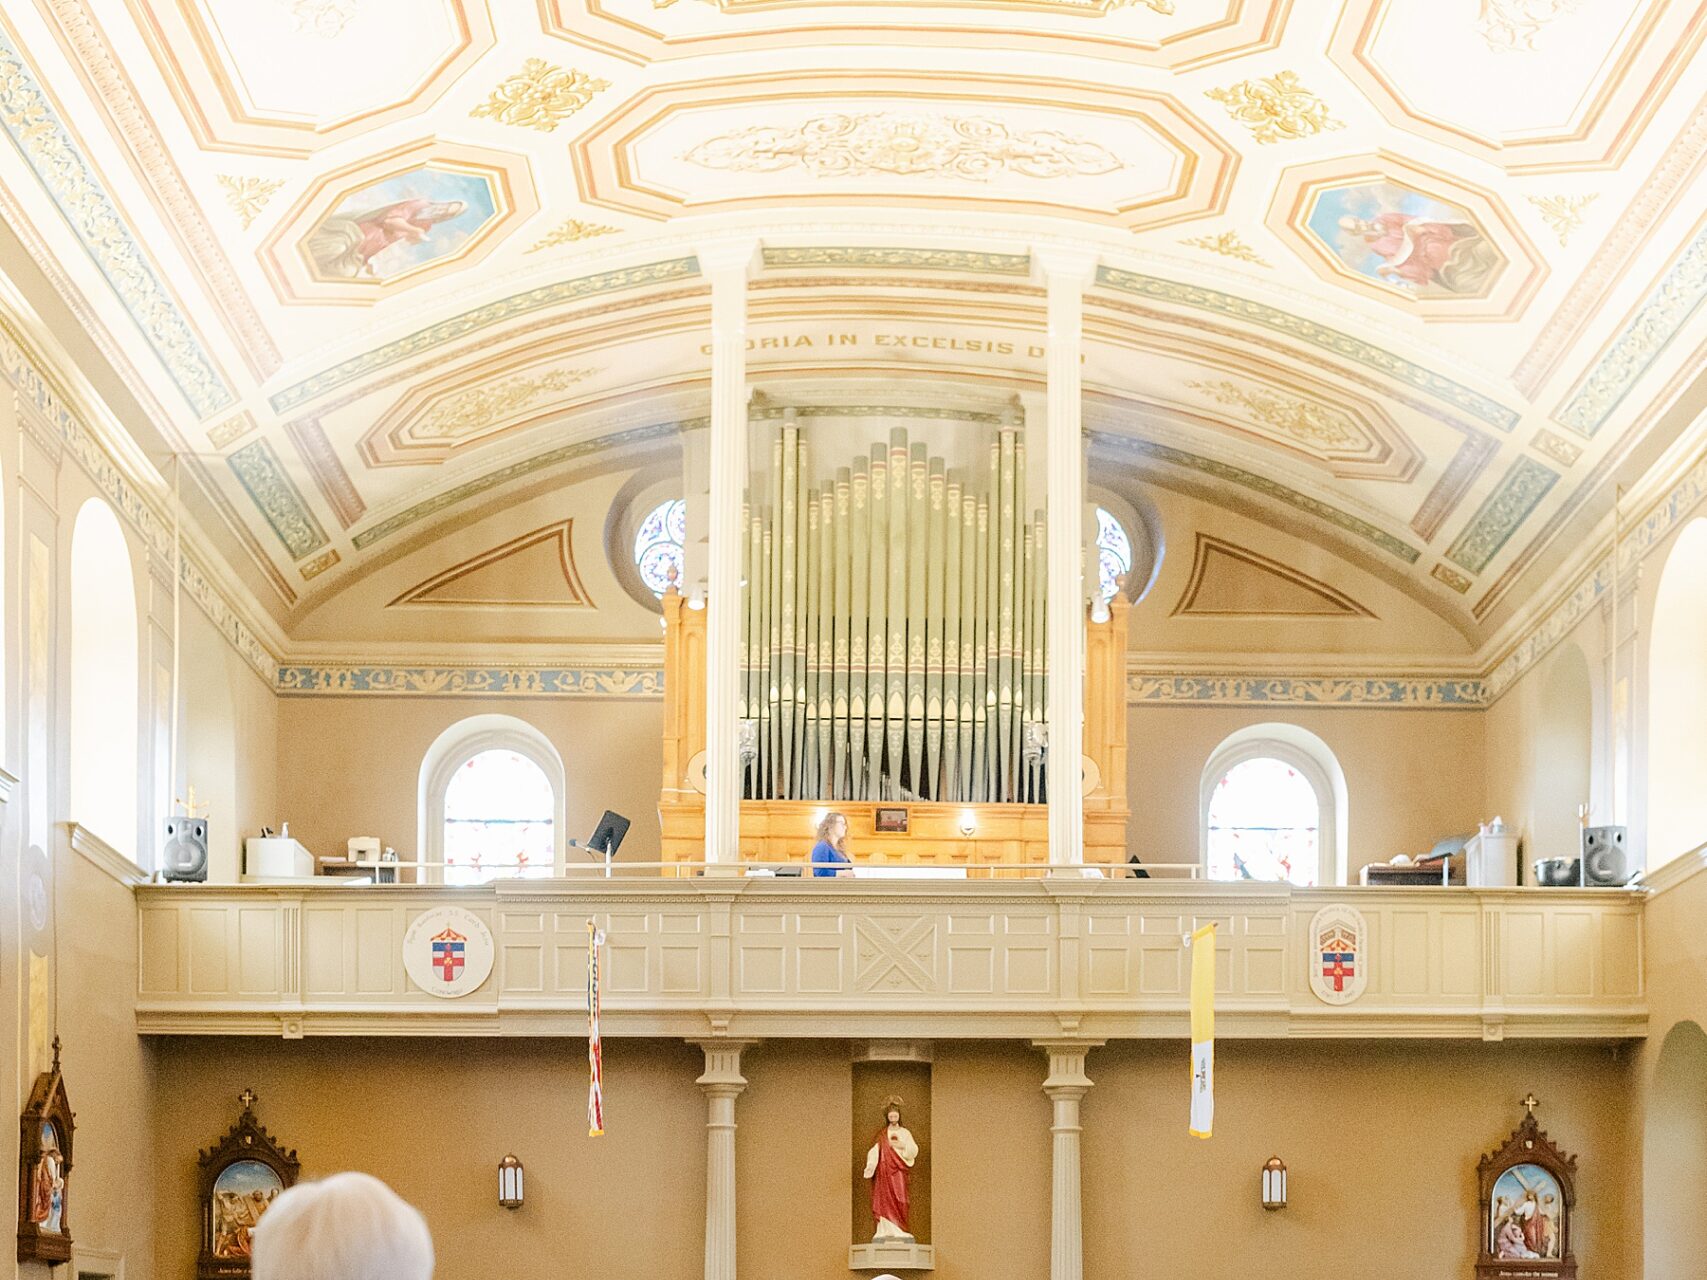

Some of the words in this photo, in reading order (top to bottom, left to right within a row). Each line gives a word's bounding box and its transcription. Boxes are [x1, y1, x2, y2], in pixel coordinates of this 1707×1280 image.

[700, 335, 813, 356] GORIA
[828, 333, 858, 347] IN
[874, 334, 1015, 355] EXCELSIS
